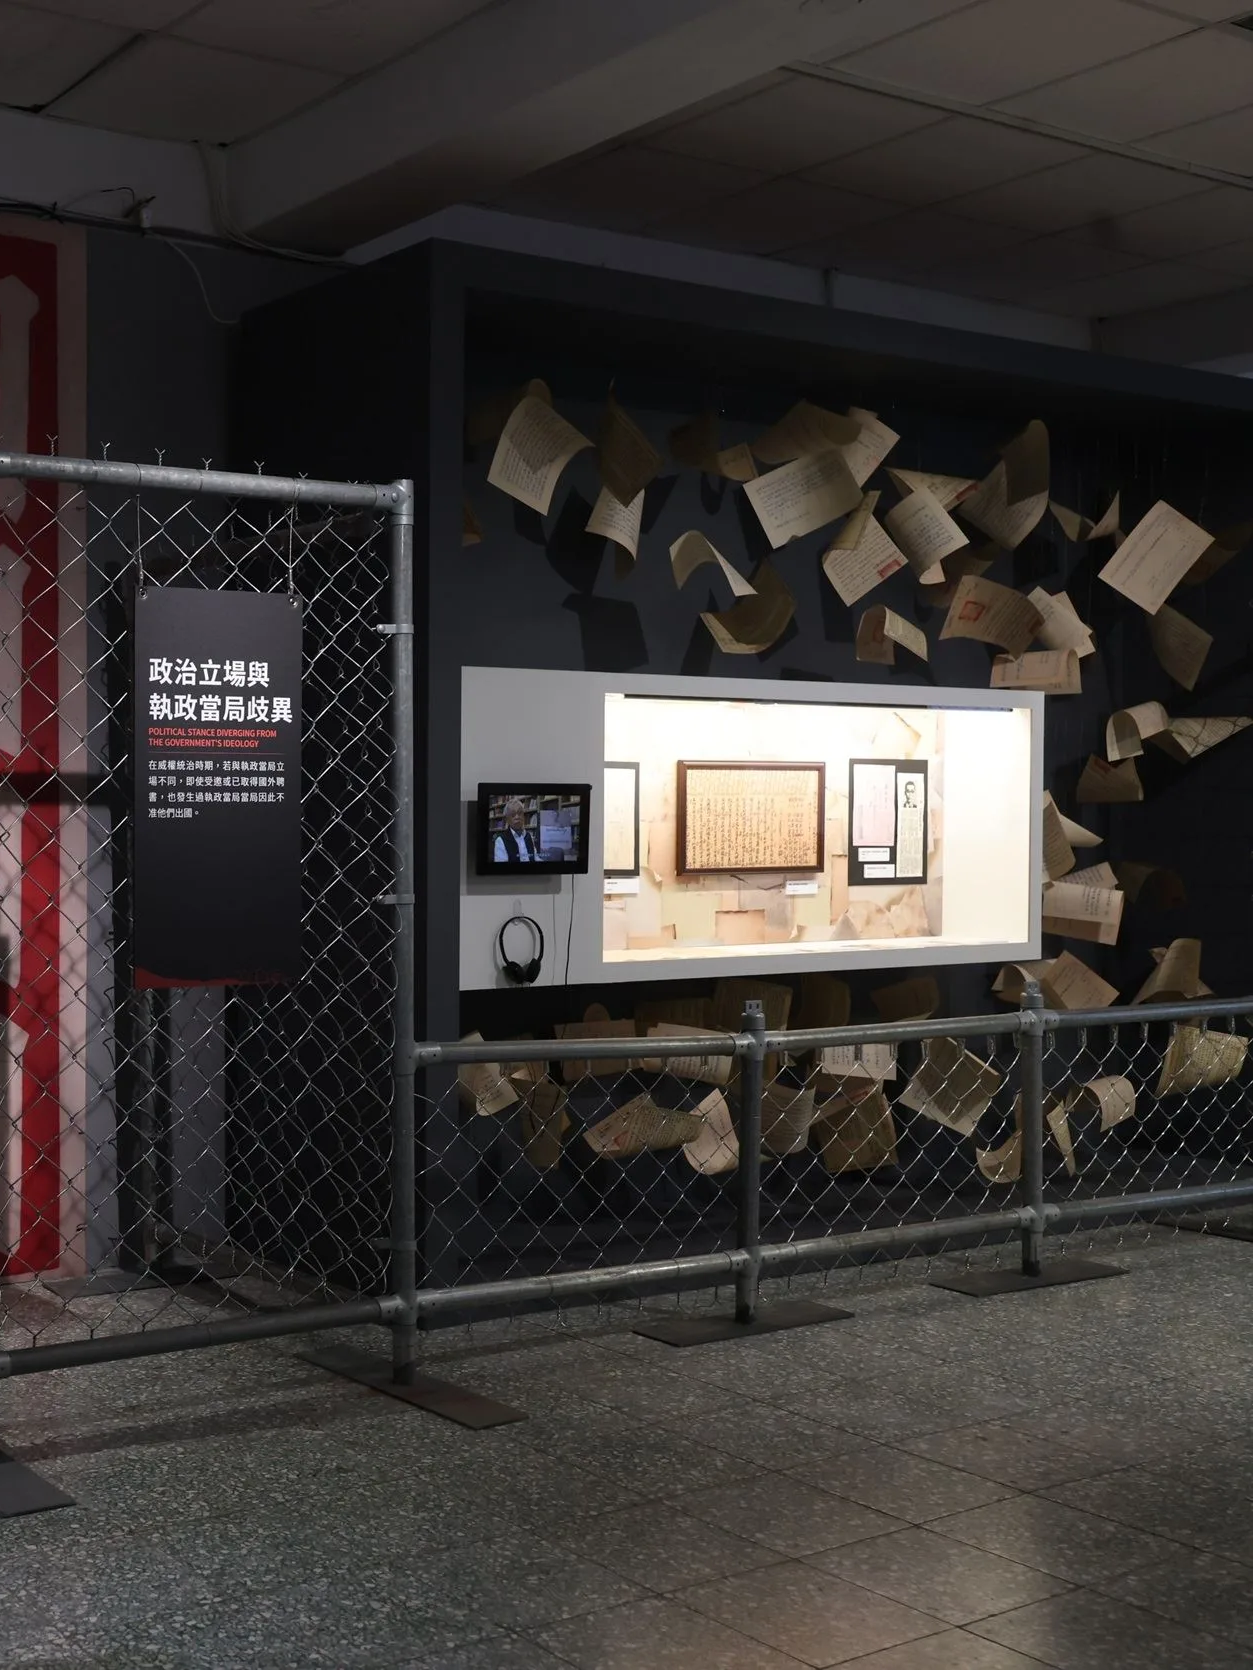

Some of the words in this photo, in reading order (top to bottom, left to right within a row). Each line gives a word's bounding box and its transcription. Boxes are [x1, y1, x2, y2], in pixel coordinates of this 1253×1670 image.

[149, 657, 270, 688] 政治立場與
[148, 692, 293, 723] 執政當局歧異
[148, 727, 186, 737] POLITICAL
[188, 728, 215, 737] STANCE
[216, 729, 256, 738] DIVERGING
[256, 730, 277, 738] FROM
[148, 738, 164, 746] THE
[164, 738, 223, 747] GOVERNMENT'S
[223, 739, 260, 748] IDEOLOGY
[148, 760, 285, 772] 在威權統治時期，若與執政當局立
[148, 807, 200, 818] 准他們出國。
